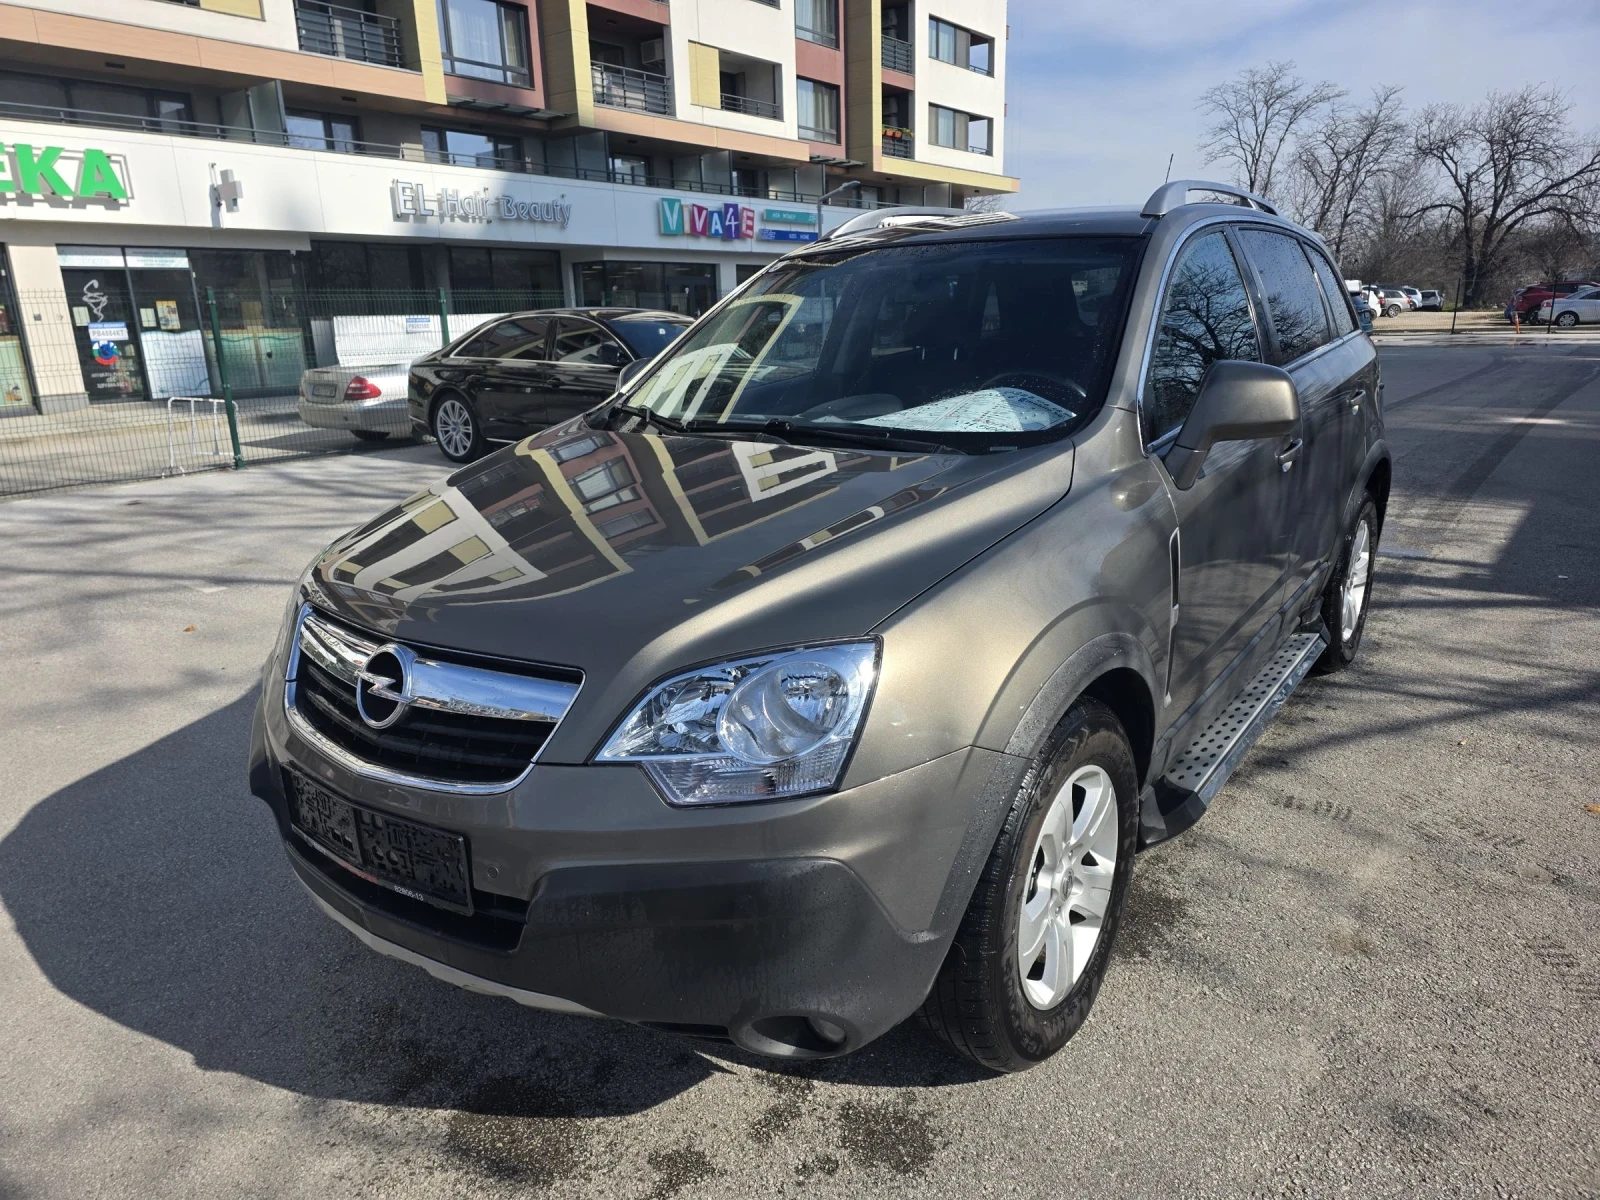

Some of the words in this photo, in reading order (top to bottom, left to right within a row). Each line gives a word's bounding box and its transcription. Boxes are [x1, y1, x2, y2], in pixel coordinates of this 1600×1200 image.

[397, 181, 434, 217] EL
[441, 187, 490, 218] Hair
[501, 195, 571, 228] Beauty
